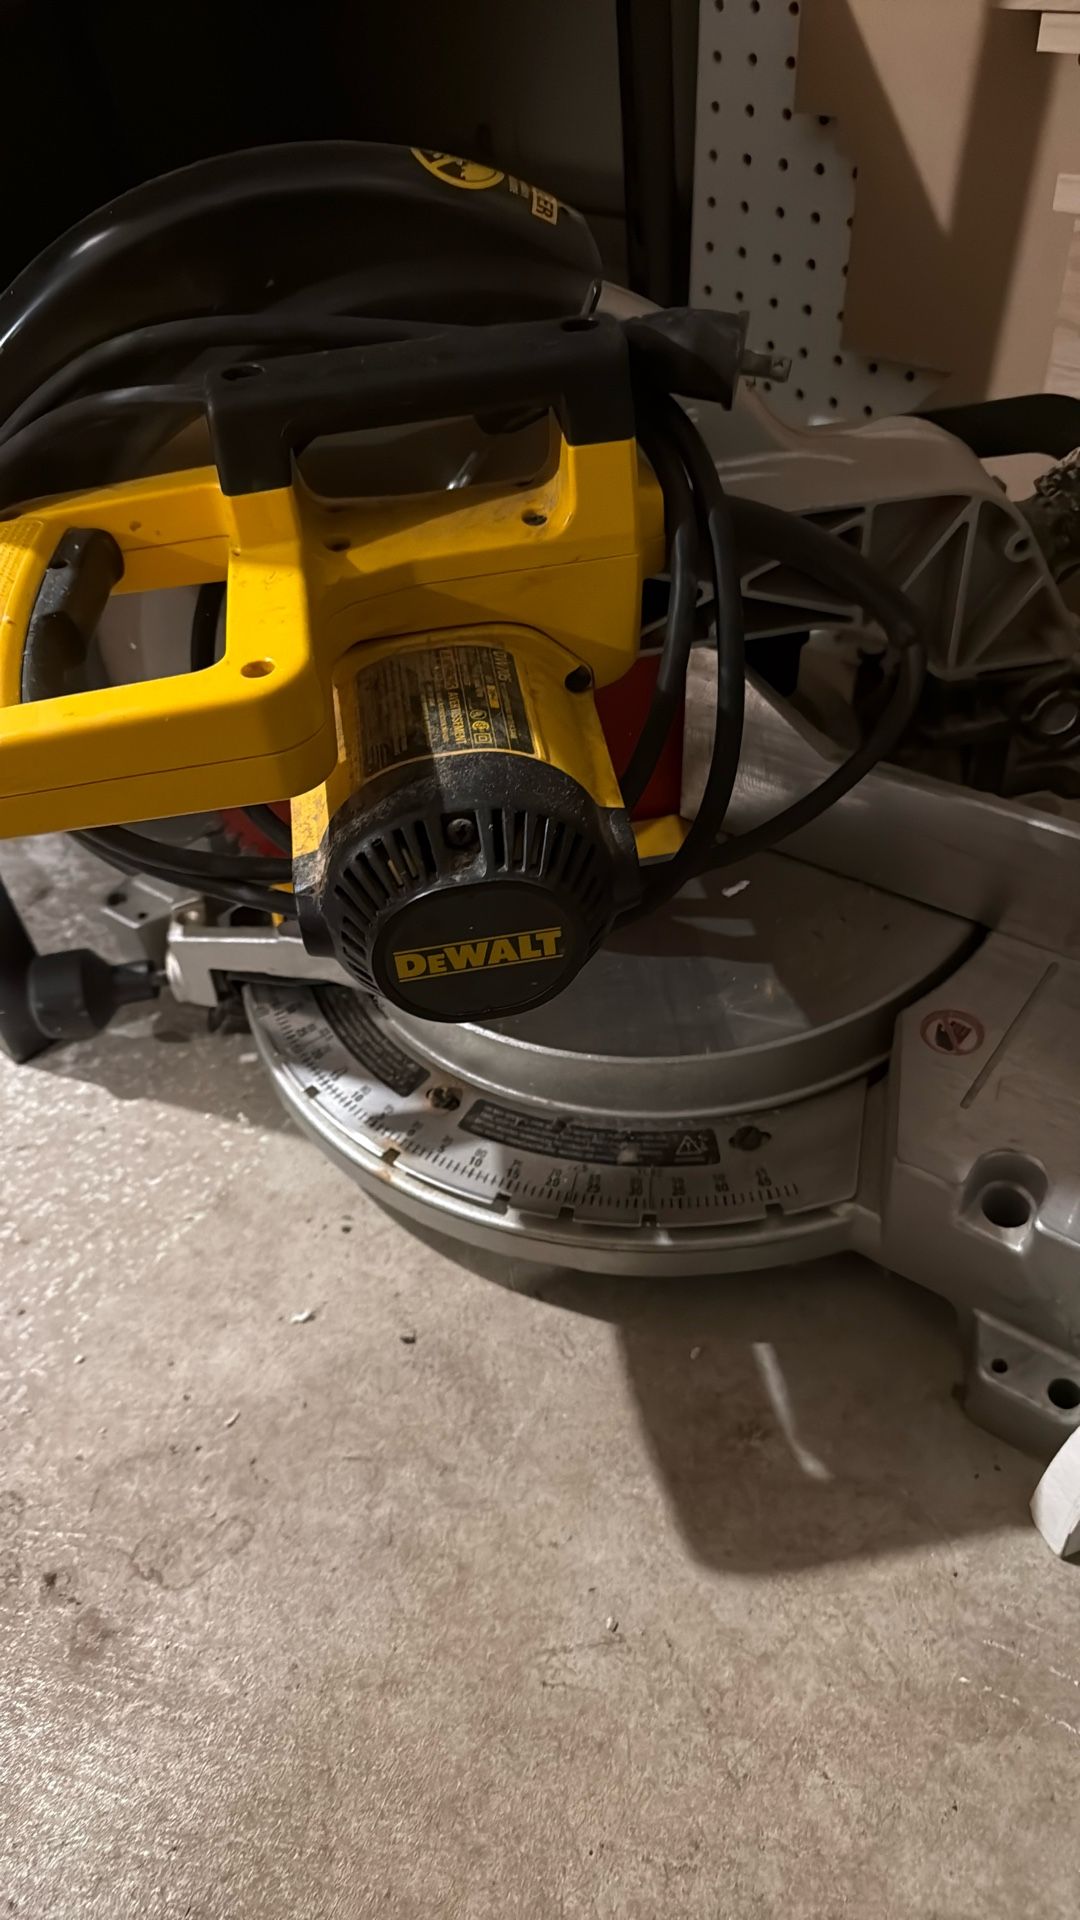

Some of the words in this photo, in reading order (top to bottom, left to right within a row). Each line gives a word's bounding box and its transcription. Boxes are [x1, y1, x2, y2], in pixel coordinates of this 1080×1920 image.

[447, 691, 467, 744] AVERTISSEMENT
[351, 1091, 364, 1102] 10
[469, 1156, 482, 1167] 10
[507, 1168, 519, 1180] 15
[546, 1176, 560, 1187] 20
